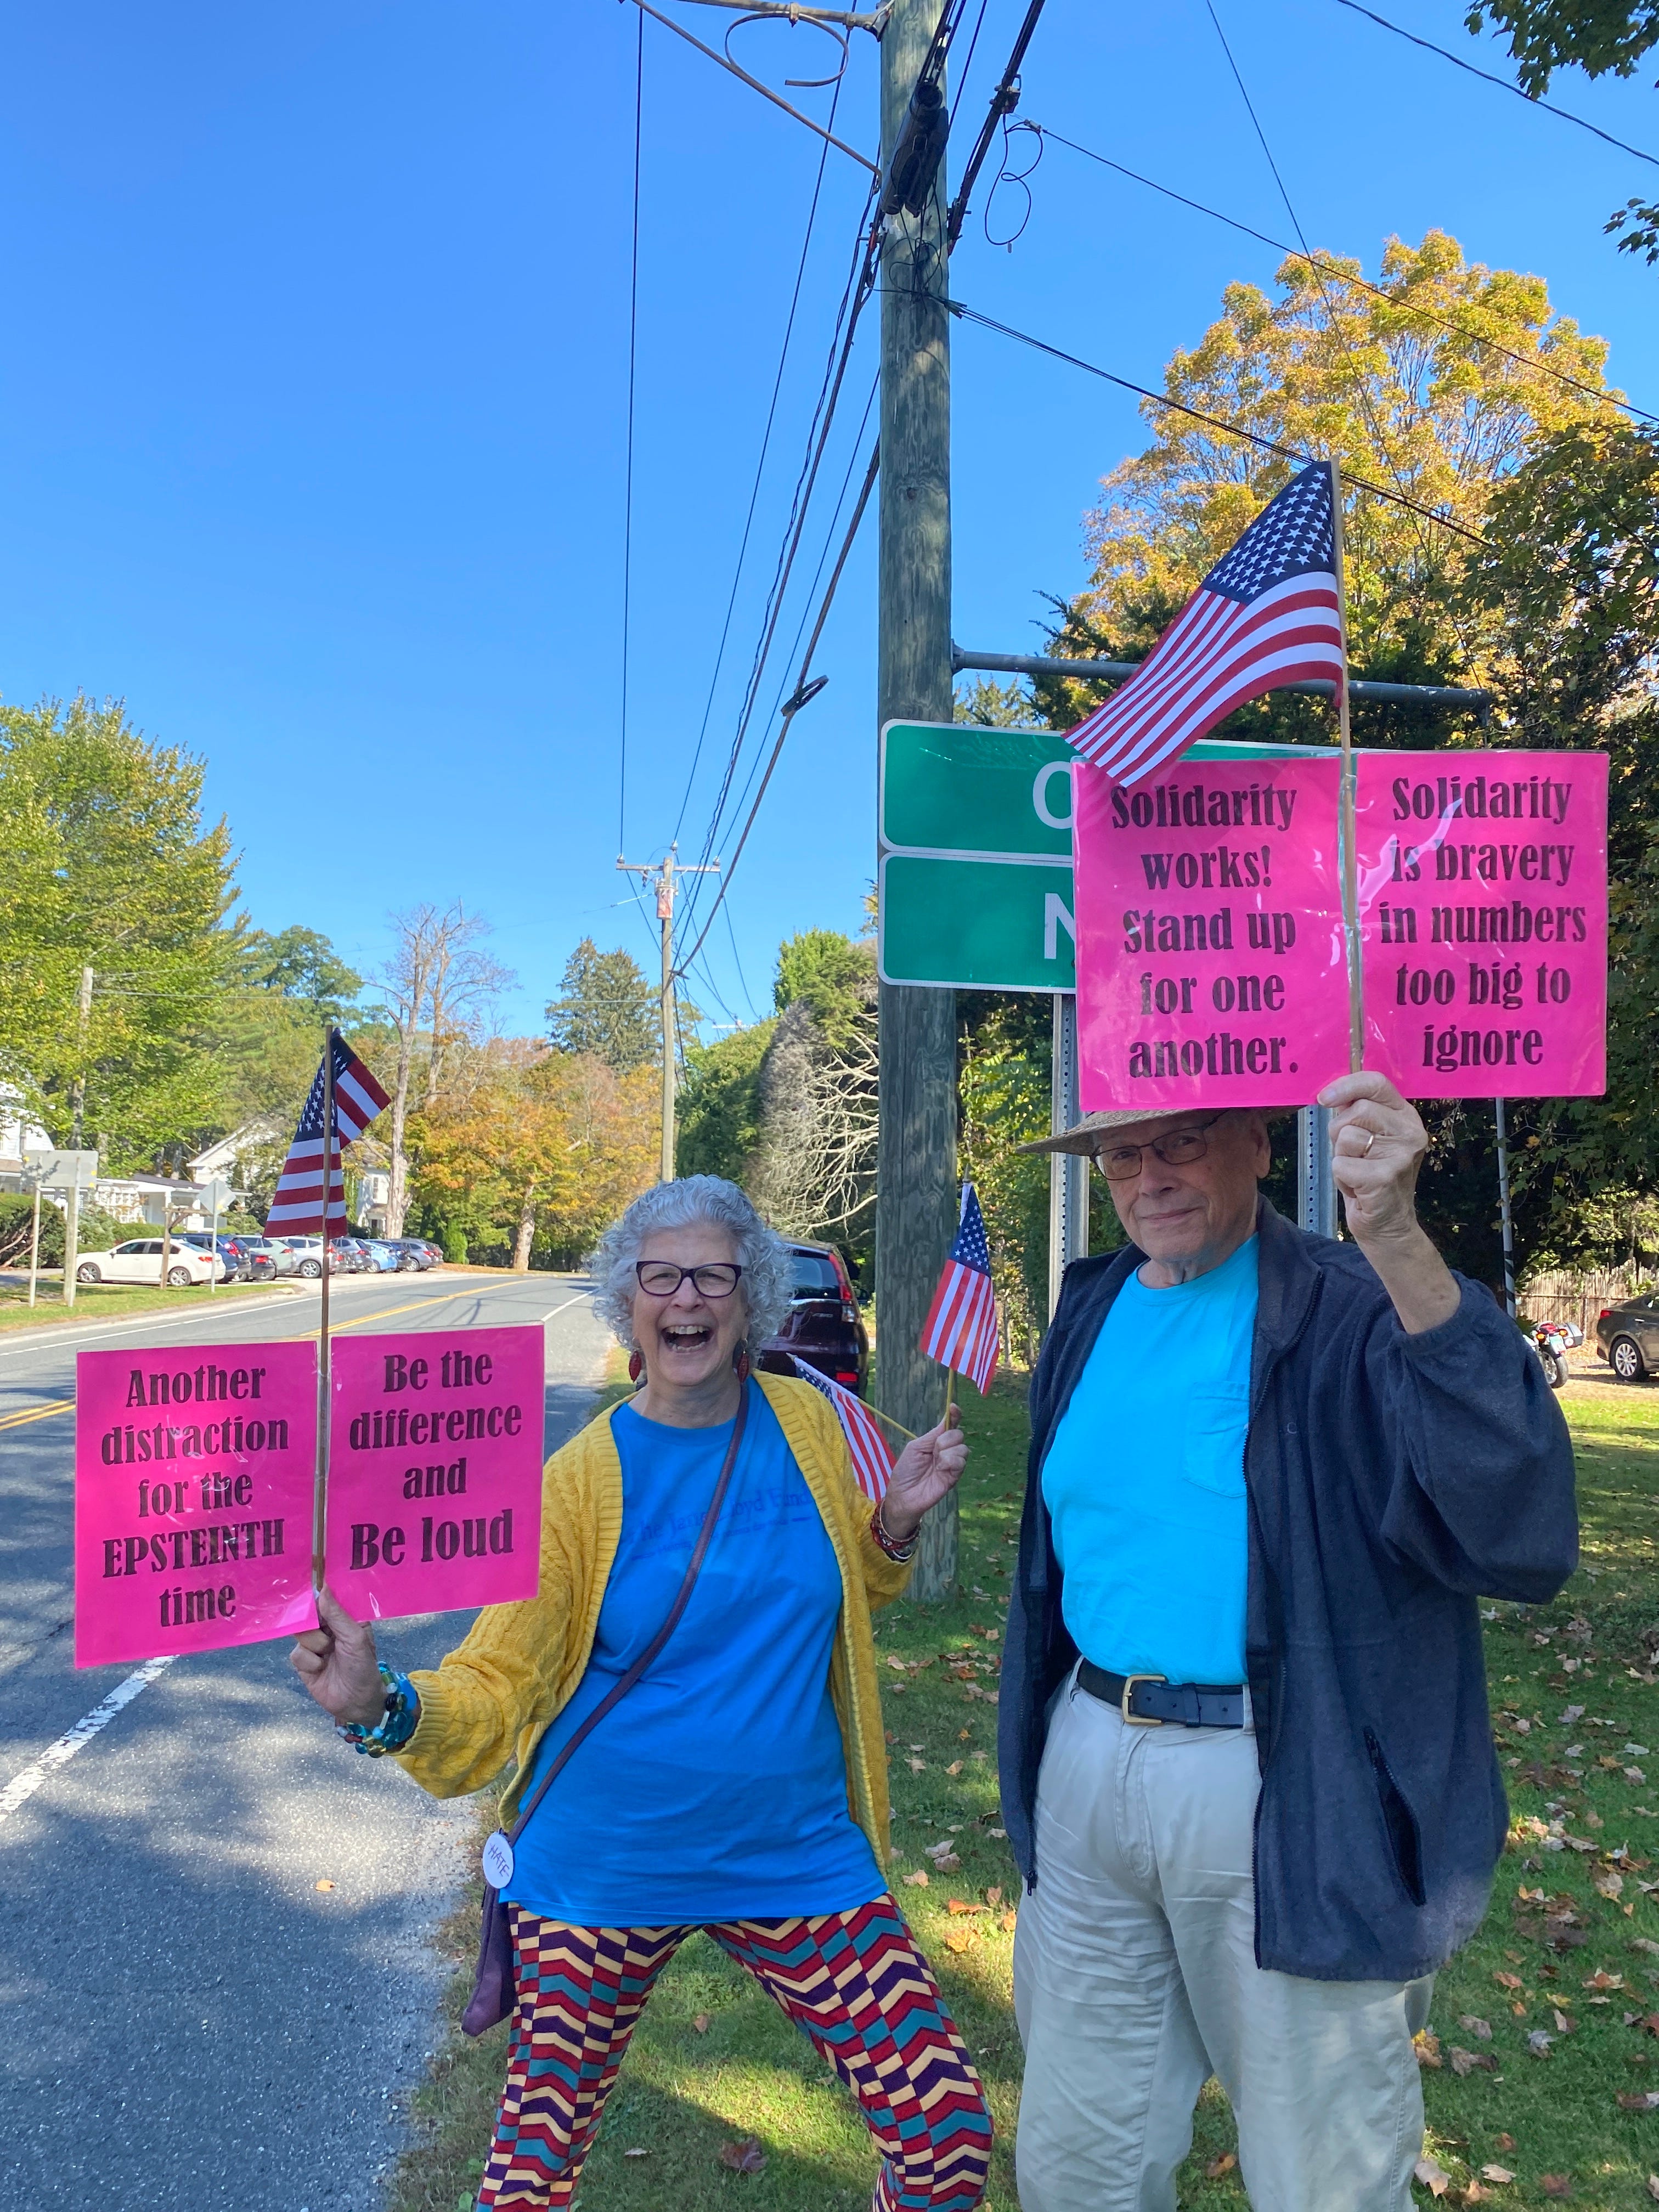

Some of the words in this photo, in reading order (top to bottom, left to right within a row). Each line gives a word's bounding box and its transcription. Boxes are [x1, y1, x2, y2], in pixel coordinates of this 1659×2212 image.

[1111, 783, 1296, 831] Solidarity
[1392, 776, 1572, 825] Solidarity
[1140, 845, 1271, 890] works!
[1391, 839, 1421, 882] is
[1434, 839, 1575, 887] bravery
[1122, 907, 1234, 953] Stand
[1246, 912, 1296, 955] up
[1379, 901, 1418, 944] in
[1431, 900, 1586, 943] numbers
[1139, 972, 1197, 1015] for
[1212, 974, 1285, 1013] one
[1396, 963, 1455, 1006] too
[1468, 962, 1523, 1010] big
[1536, 962, 1571, 1004] to
[1129, 1032, 1298, 1078] another.
[1422, 1024, 1543, 1073] ignore
[126, 1364, 267, 1408] Another
[383, 1355, 428, 1393] Be
[441, 1350, 492, 1388] the
[101, 1415, 289, 1465] distraction
[349, 1405, 522, 1451] difference
[138, 1479, 189, 1518] for
[200, 1471, 253, 1510] the
[403, 1457, 467, 1499] and
[102, 1518, 285, 1578] EPSTEINTH
[349, 1523, 405, 1570] Be
[421, 1509, 514, 1562] loud
[159, 1585, 236, 1627] time
[488, 1844, 510, 1877] HATE
